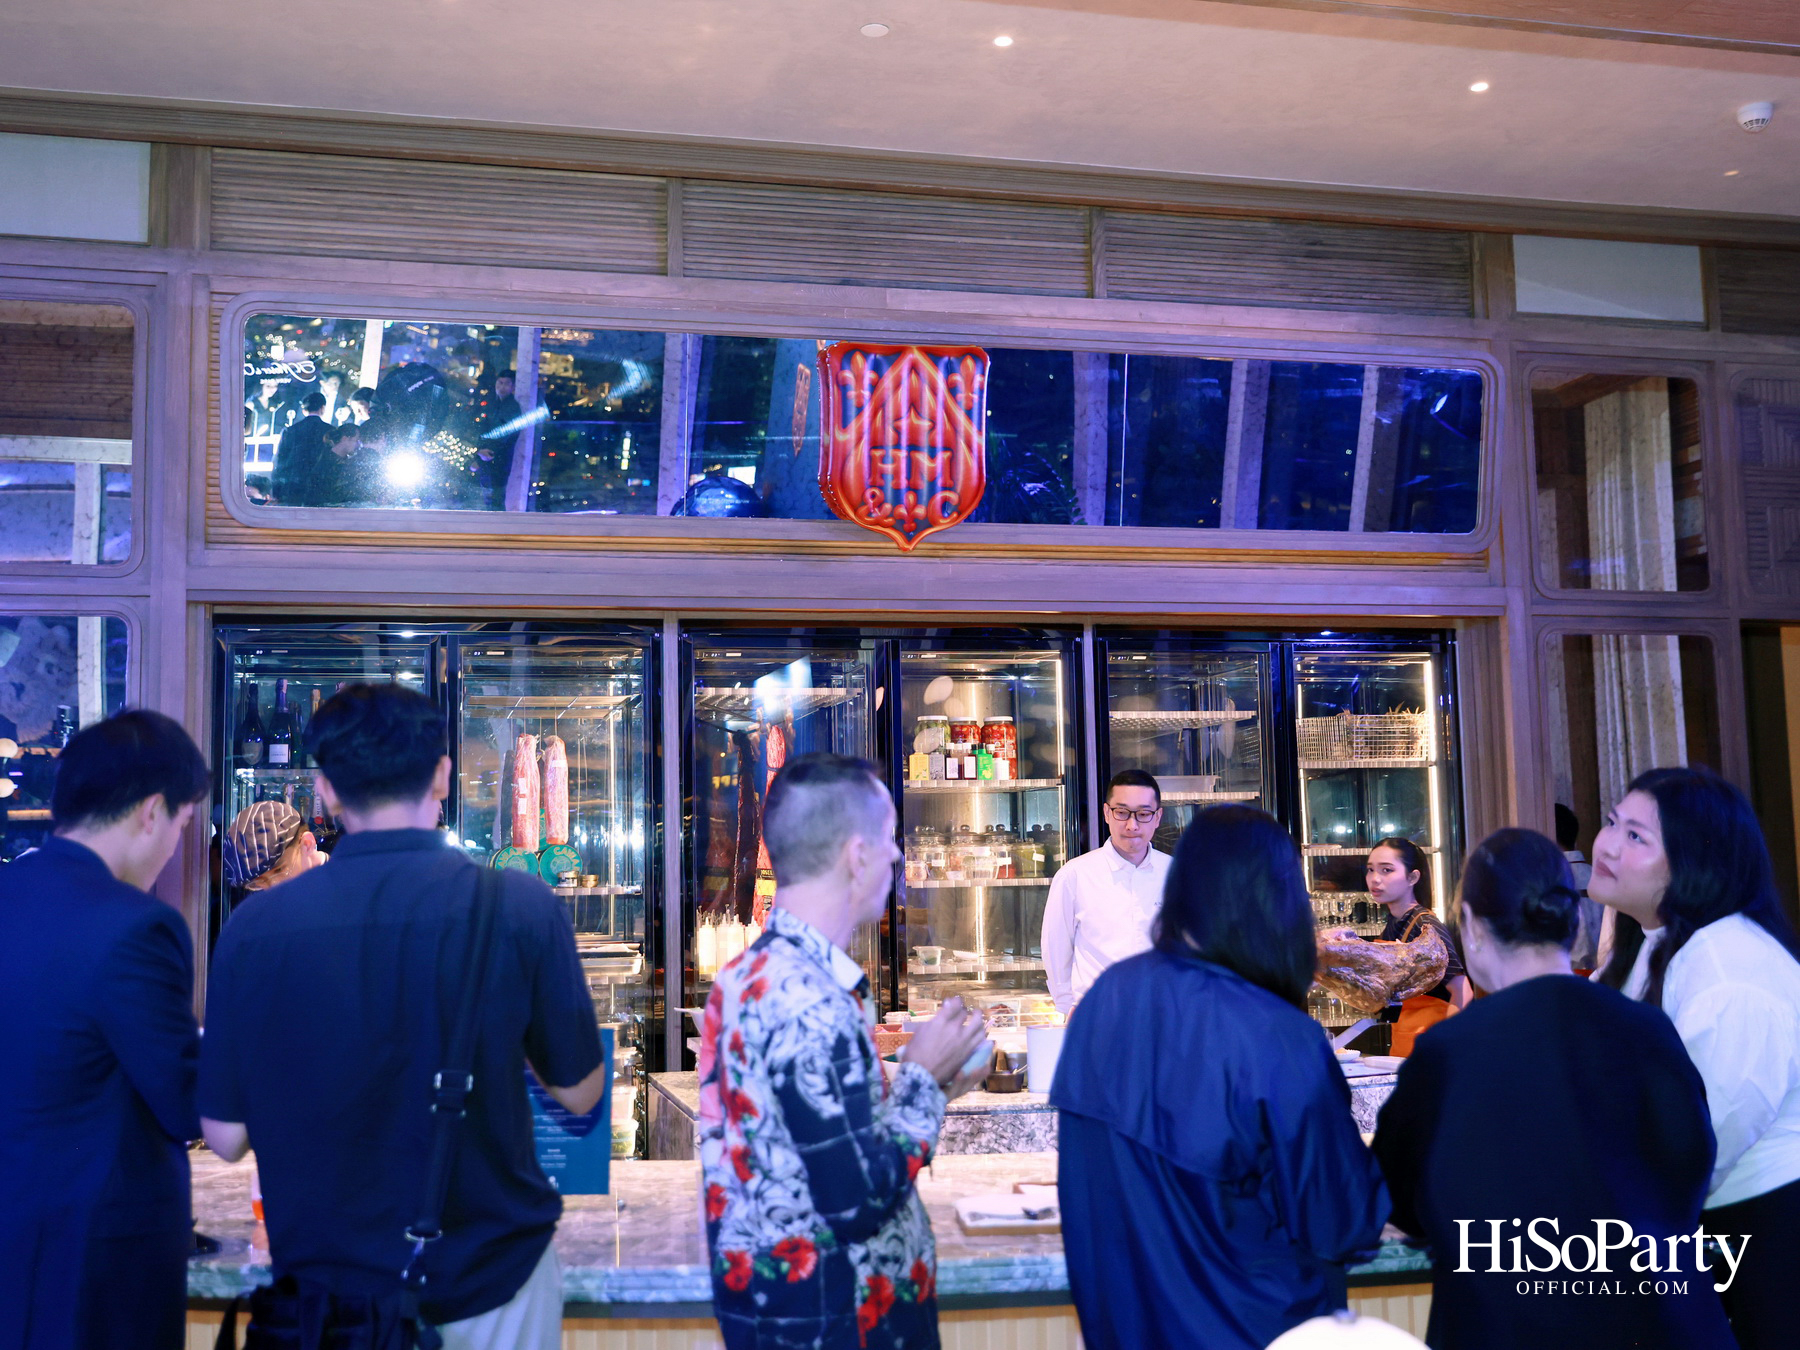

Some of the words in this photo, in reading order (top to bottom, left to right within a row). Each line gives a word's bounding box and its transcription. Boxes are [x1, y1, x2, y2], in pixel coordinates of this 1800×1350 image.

[869, 448, 955, 490] HM
[856, 487, 896, 529] &
[927, 490, 959, 527] C
